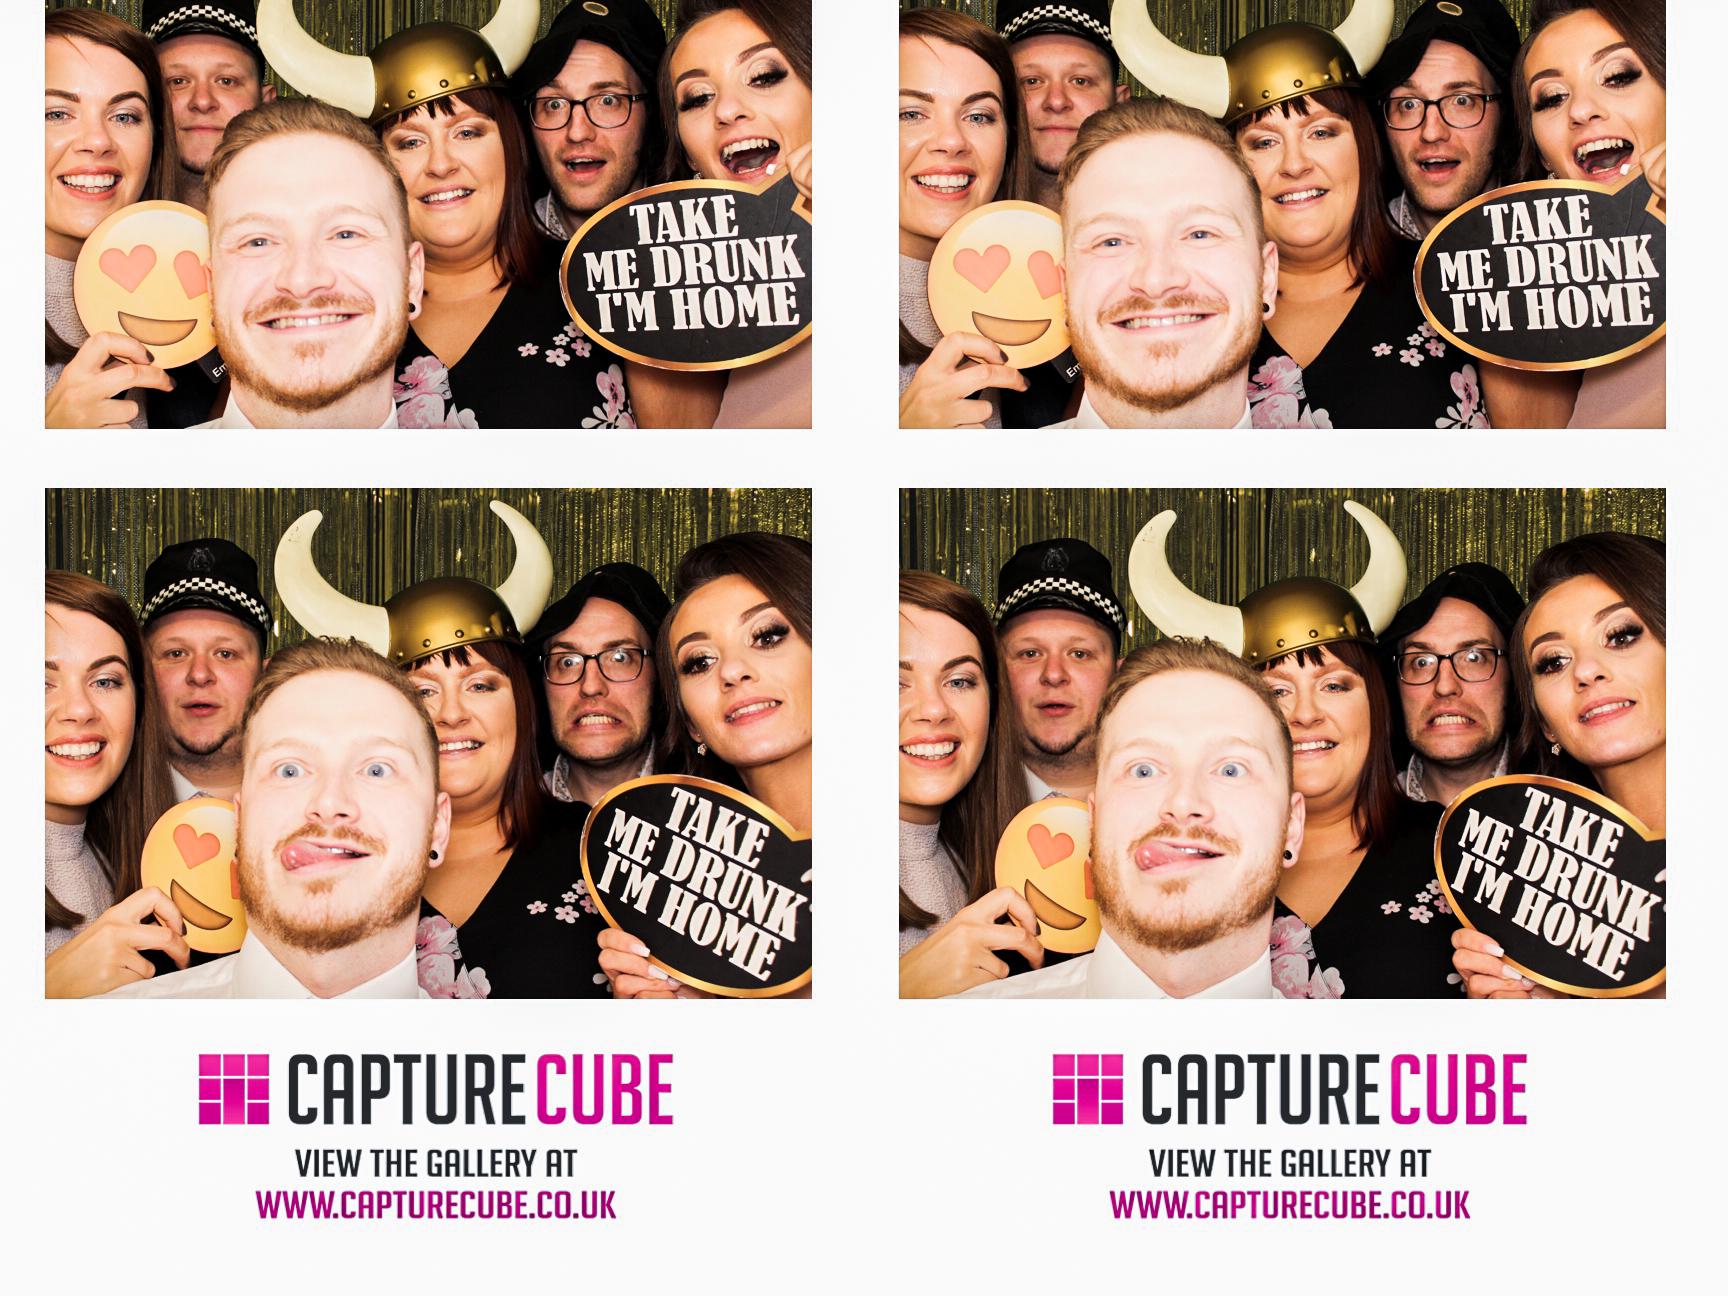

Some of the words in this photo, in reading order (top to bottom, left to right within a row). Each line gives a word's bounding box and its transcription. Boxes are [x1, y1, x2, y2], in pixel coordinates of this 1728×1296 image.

[629, 194, 739, 245] TAKE
[1483, 194, 1593, 245] TAKE
[583, 249, 640, 292] ME
[649, 234, 806, 288] DRUNK
[1437, 249, 1494, 292] ME
[1503, 234, 1660, 288] DRUNK
[595, 290, 660, 333] I'M
[669, 281, 800, 330] HOME
[1449, 290, 1514, 333] I'M
[1523, 281, 1654, 330] HOME
[665, 786, 771, 869] TAKE
[1519, 786, 1625, 869] TAKE
[604, 807, 660, 867] ME
[659, 835, 808, 943] DRUNK
[1458, 807, 1514, 867] ME
[1513, 835, 1662, 943] DRUNK
[596, 851, 660, 915] I'M
[657, 883, 782, 982] HOME
[1450, 851, 1514, 915] I'M
[1511, 883, 1636, 982] HOME
